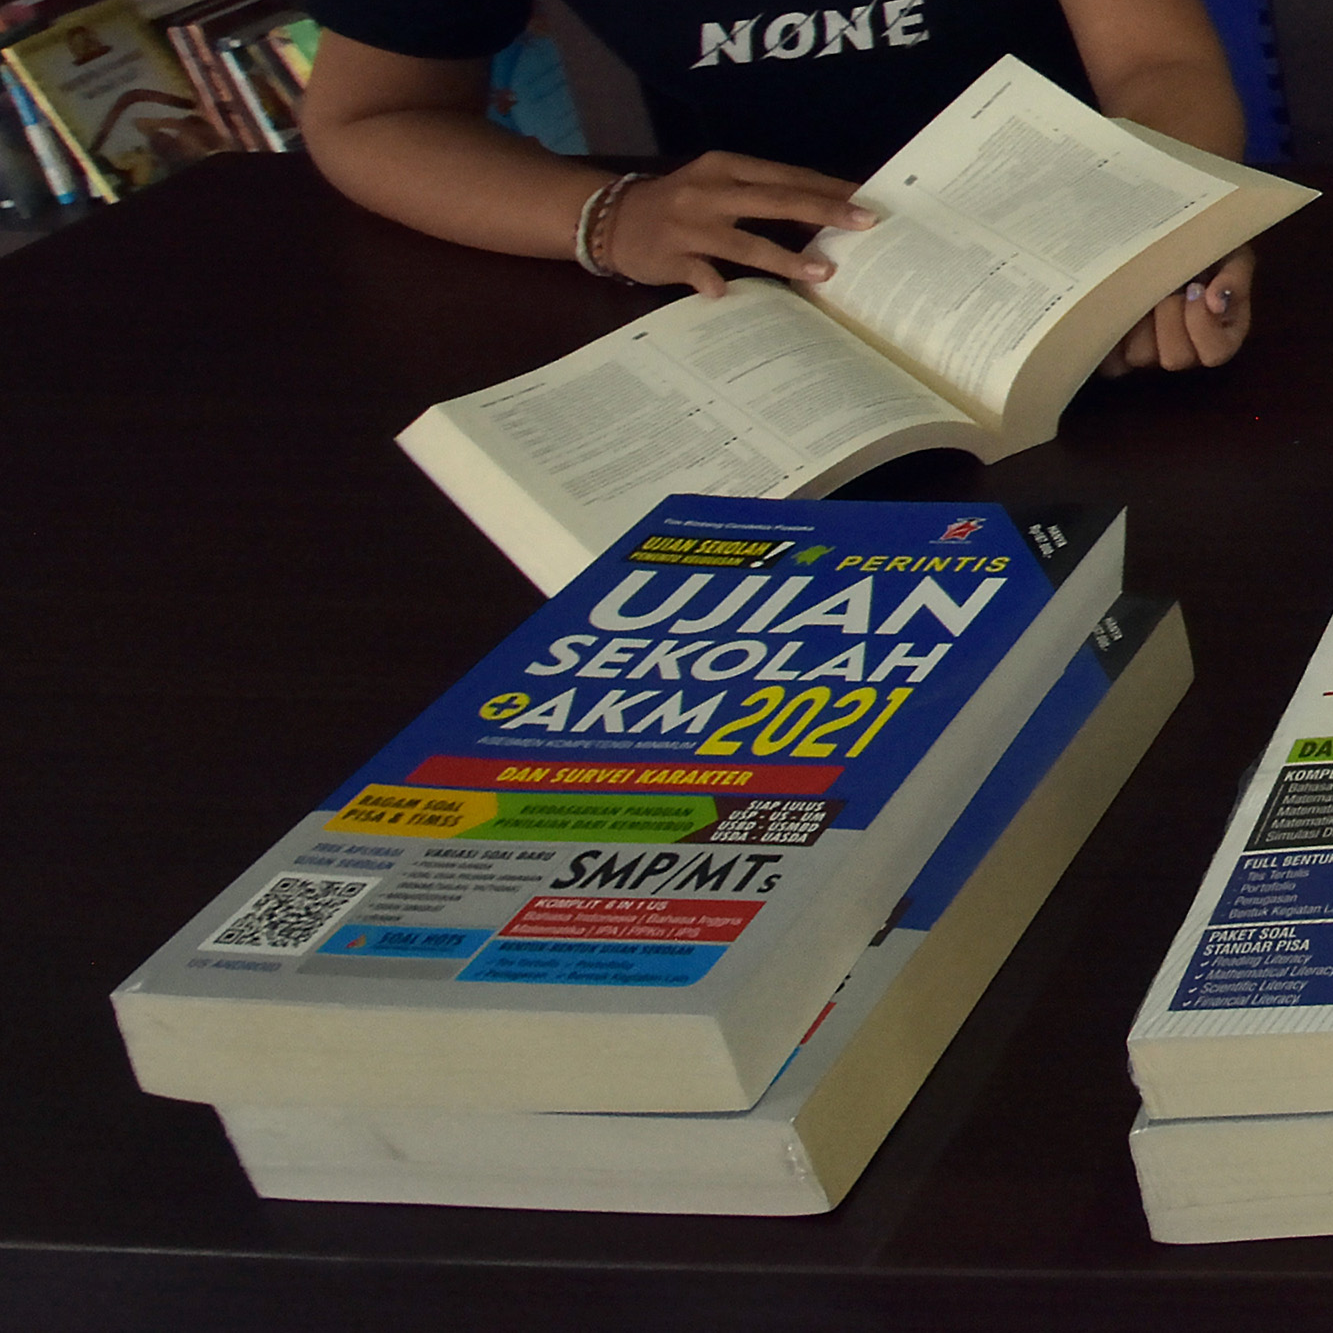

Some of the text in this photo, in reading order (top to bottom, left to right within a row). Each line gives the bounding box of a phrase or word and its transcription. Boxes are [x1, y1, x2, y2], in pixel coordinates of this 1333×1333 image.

[642, 536, 773, 556] UJIAN SEKOLAH
[834, 554, 1012, 574] PERINTIS
[589, 569, 1007, 637] UJIAN
[524, 634, 953, 683] SEKOLAH
[500, 685, 914, 758] AKM 2021
[496, 767, 754, 786] DAN SURVEI KARAKTER
[749, 800, 826, 812] SIAP LULUS
[729, 810, 826, 822] USP UM
[710, 831, 809, 844] USDA UASDA
[1243, 856, 1281, 870] FULL
[551, 849, 783, 896] SMP/MTs
[535, 897, 599, 911] KOMPLIT
[1208, 927, 1297, 943] PAKET SOAL
[1203, 939, 1310, 956] STANDAR PISA
